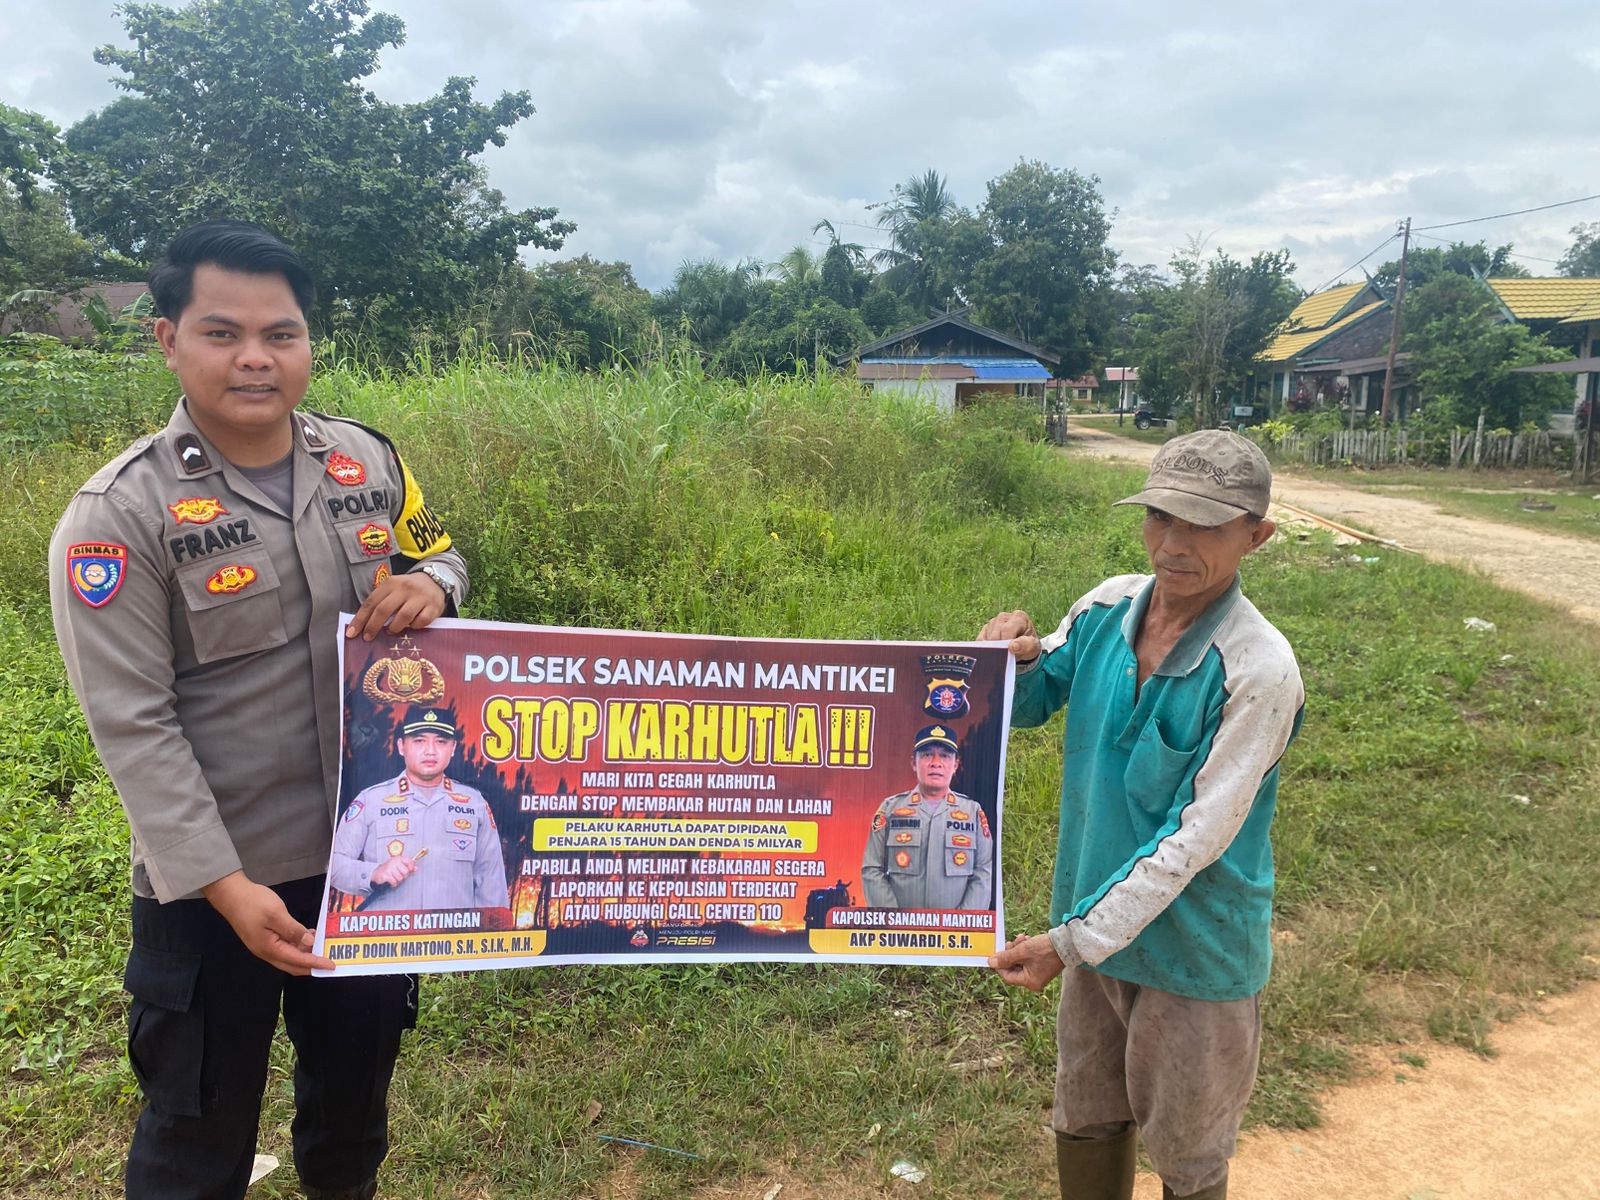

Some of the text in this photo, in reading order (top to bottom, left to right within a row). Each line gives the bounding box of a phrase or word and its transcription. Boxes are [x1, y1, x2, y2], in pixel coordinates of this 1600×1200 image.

[327, 488, 389, 519] POLRI
[170, 519, 257, 563] FRANZ
[73, 546, 119, 555] BINMAS
[464, 655, 895, 693] POLSEK SANAMAN MANTIKEI
[484, 697, 872, 765] STOP KARHUTLA !!!
[582, 772, 776, 790] MARI KITA CEGAH KARHUTLA
[380, 806, 409, 816] DODIK
[448, 805, 475, 815] POLRI
[521, 795, 832, 815] DENGAN STOP MEMBAKAR HUTAN DAN LAHAN
[565, 822, 787, 835] PELAKU KARHUTLA DAPAT DIPIDANA
[946, 820, 975, 831] POLRI
[549, 836, 803, 849] PENJARA 15 TAHUN DAN DENDA 15 MILYAR
[522, 858, 826, 876] APABILA ANDA MELIHAT KEBAKARAN SEGERA
[550, 881, 798, 898] LAPORKAN KE KEPOLISIAN TERDEKAT
[564, 903, 782, 920] ATAU HUBUNGI CALL CENTER 110
[832, 911, 993, 928] KAPOLSEK SANAMAN MANTIKEI
[339, 912, 481, 932] KAPOLRES KATINGAN
[329, 944, 359, 960] AKBP
[362, 942, 398, 958] DODIK
[400, 940, 454, 957] HARTONO,
[456, 938, 478, 955] S.H.,
[511, 937, 533, 952] M.H.
[656, 936, 717, 946] PRESISI
[850, 933, 973, 949] AKP SUWARDI, S.H.
